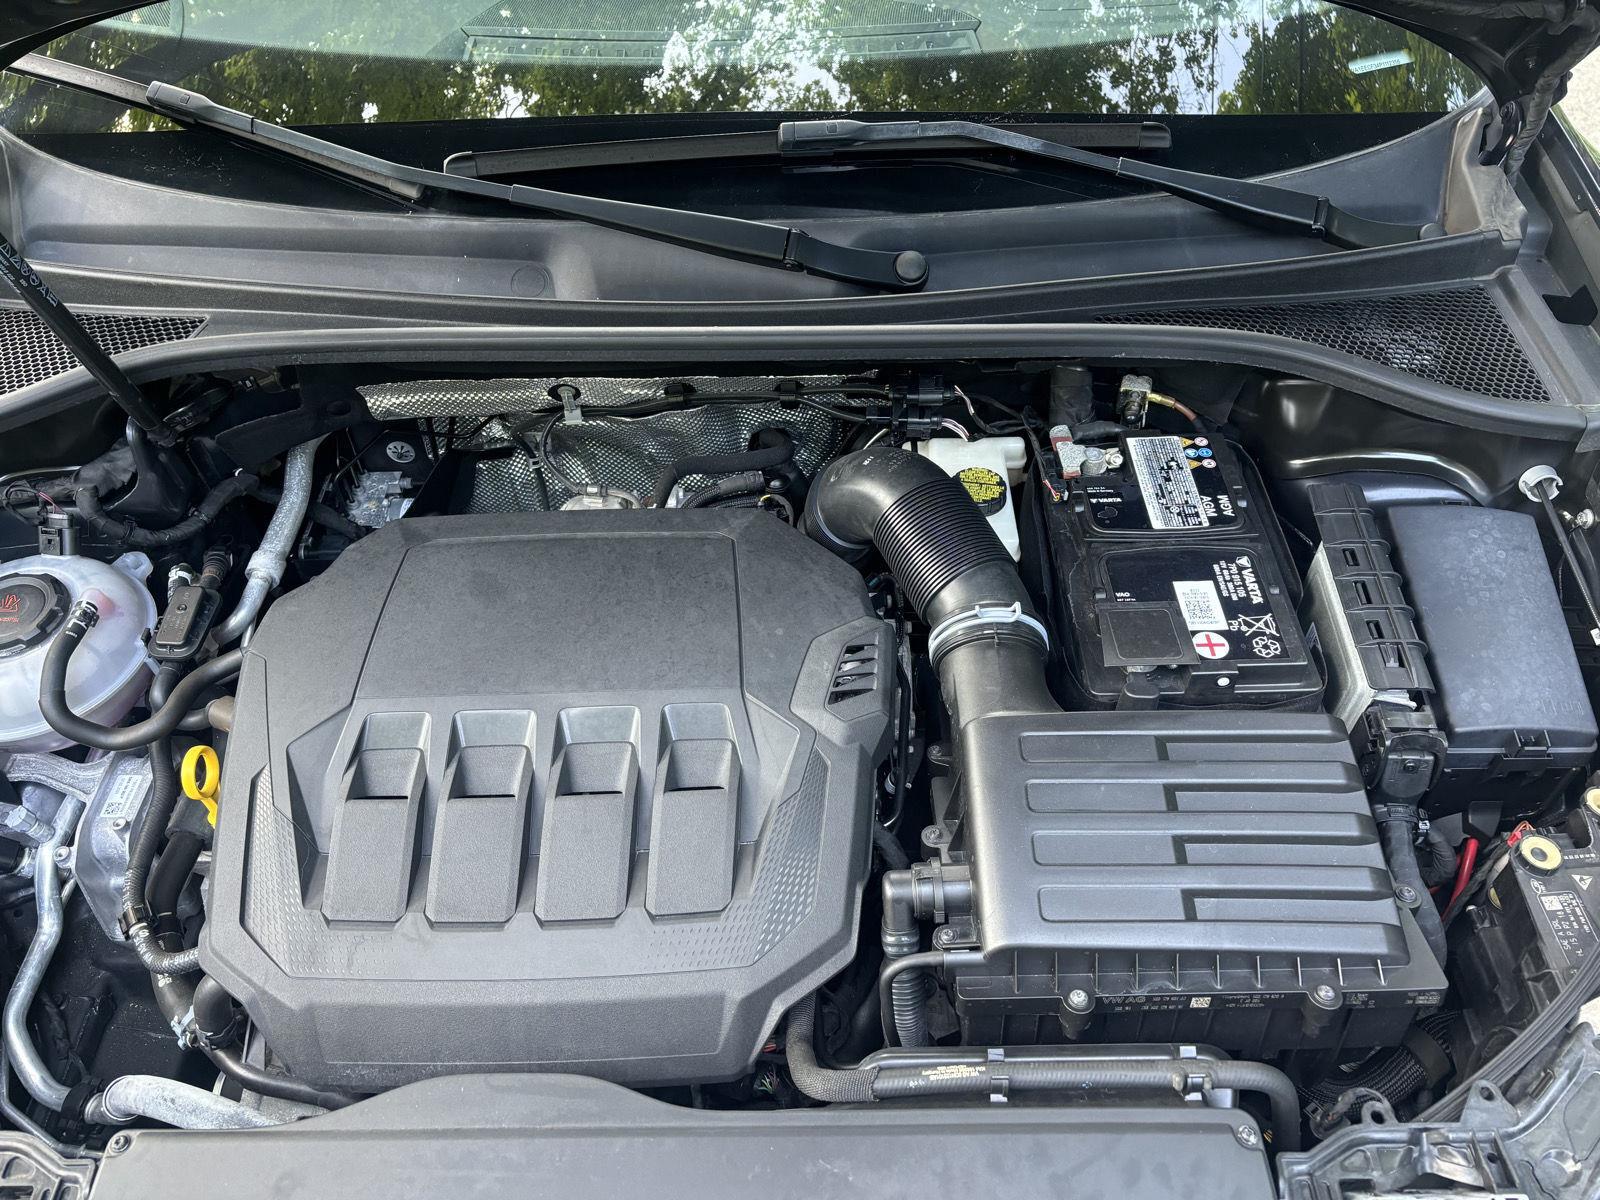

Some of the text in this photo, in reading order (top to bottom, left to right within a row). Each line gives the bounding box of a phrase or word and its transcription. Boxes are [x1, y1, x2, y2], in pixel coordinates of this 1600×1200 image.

[1200, 495, 1218, 517] AGM
[1217, 495, 1236, 517] AGM
[1241, 568, 1264, 604] VARTA
[1228, 620, 1239, 631] Pb
[1102, 996, 1125, 1005] VW
[1125, 996, 1147, 1004] AG
